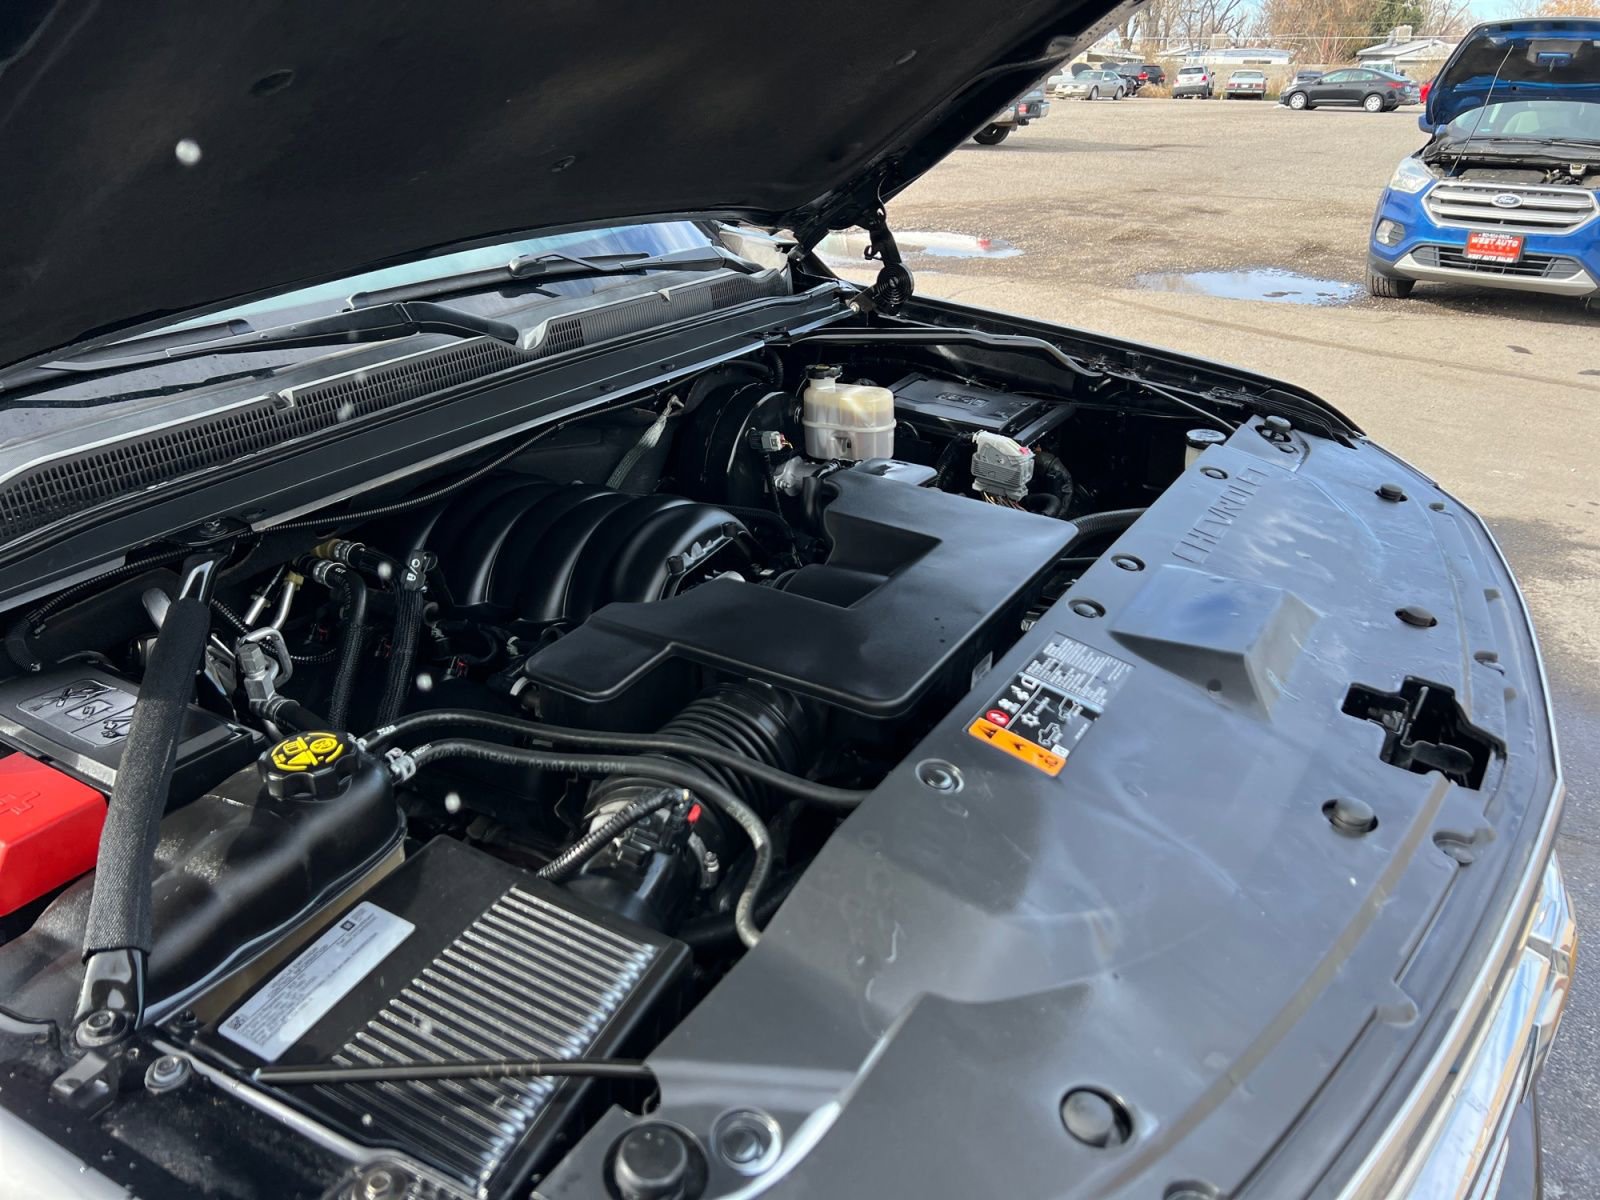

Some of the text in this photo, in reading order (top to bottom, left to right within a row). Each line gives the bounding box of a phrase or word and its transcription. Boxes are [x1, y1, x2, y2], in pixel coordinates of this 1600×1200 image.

[1471, 236, 1519, 248] WEST AUTO
[1170, 464, 1270, 564] CHEVROLET
